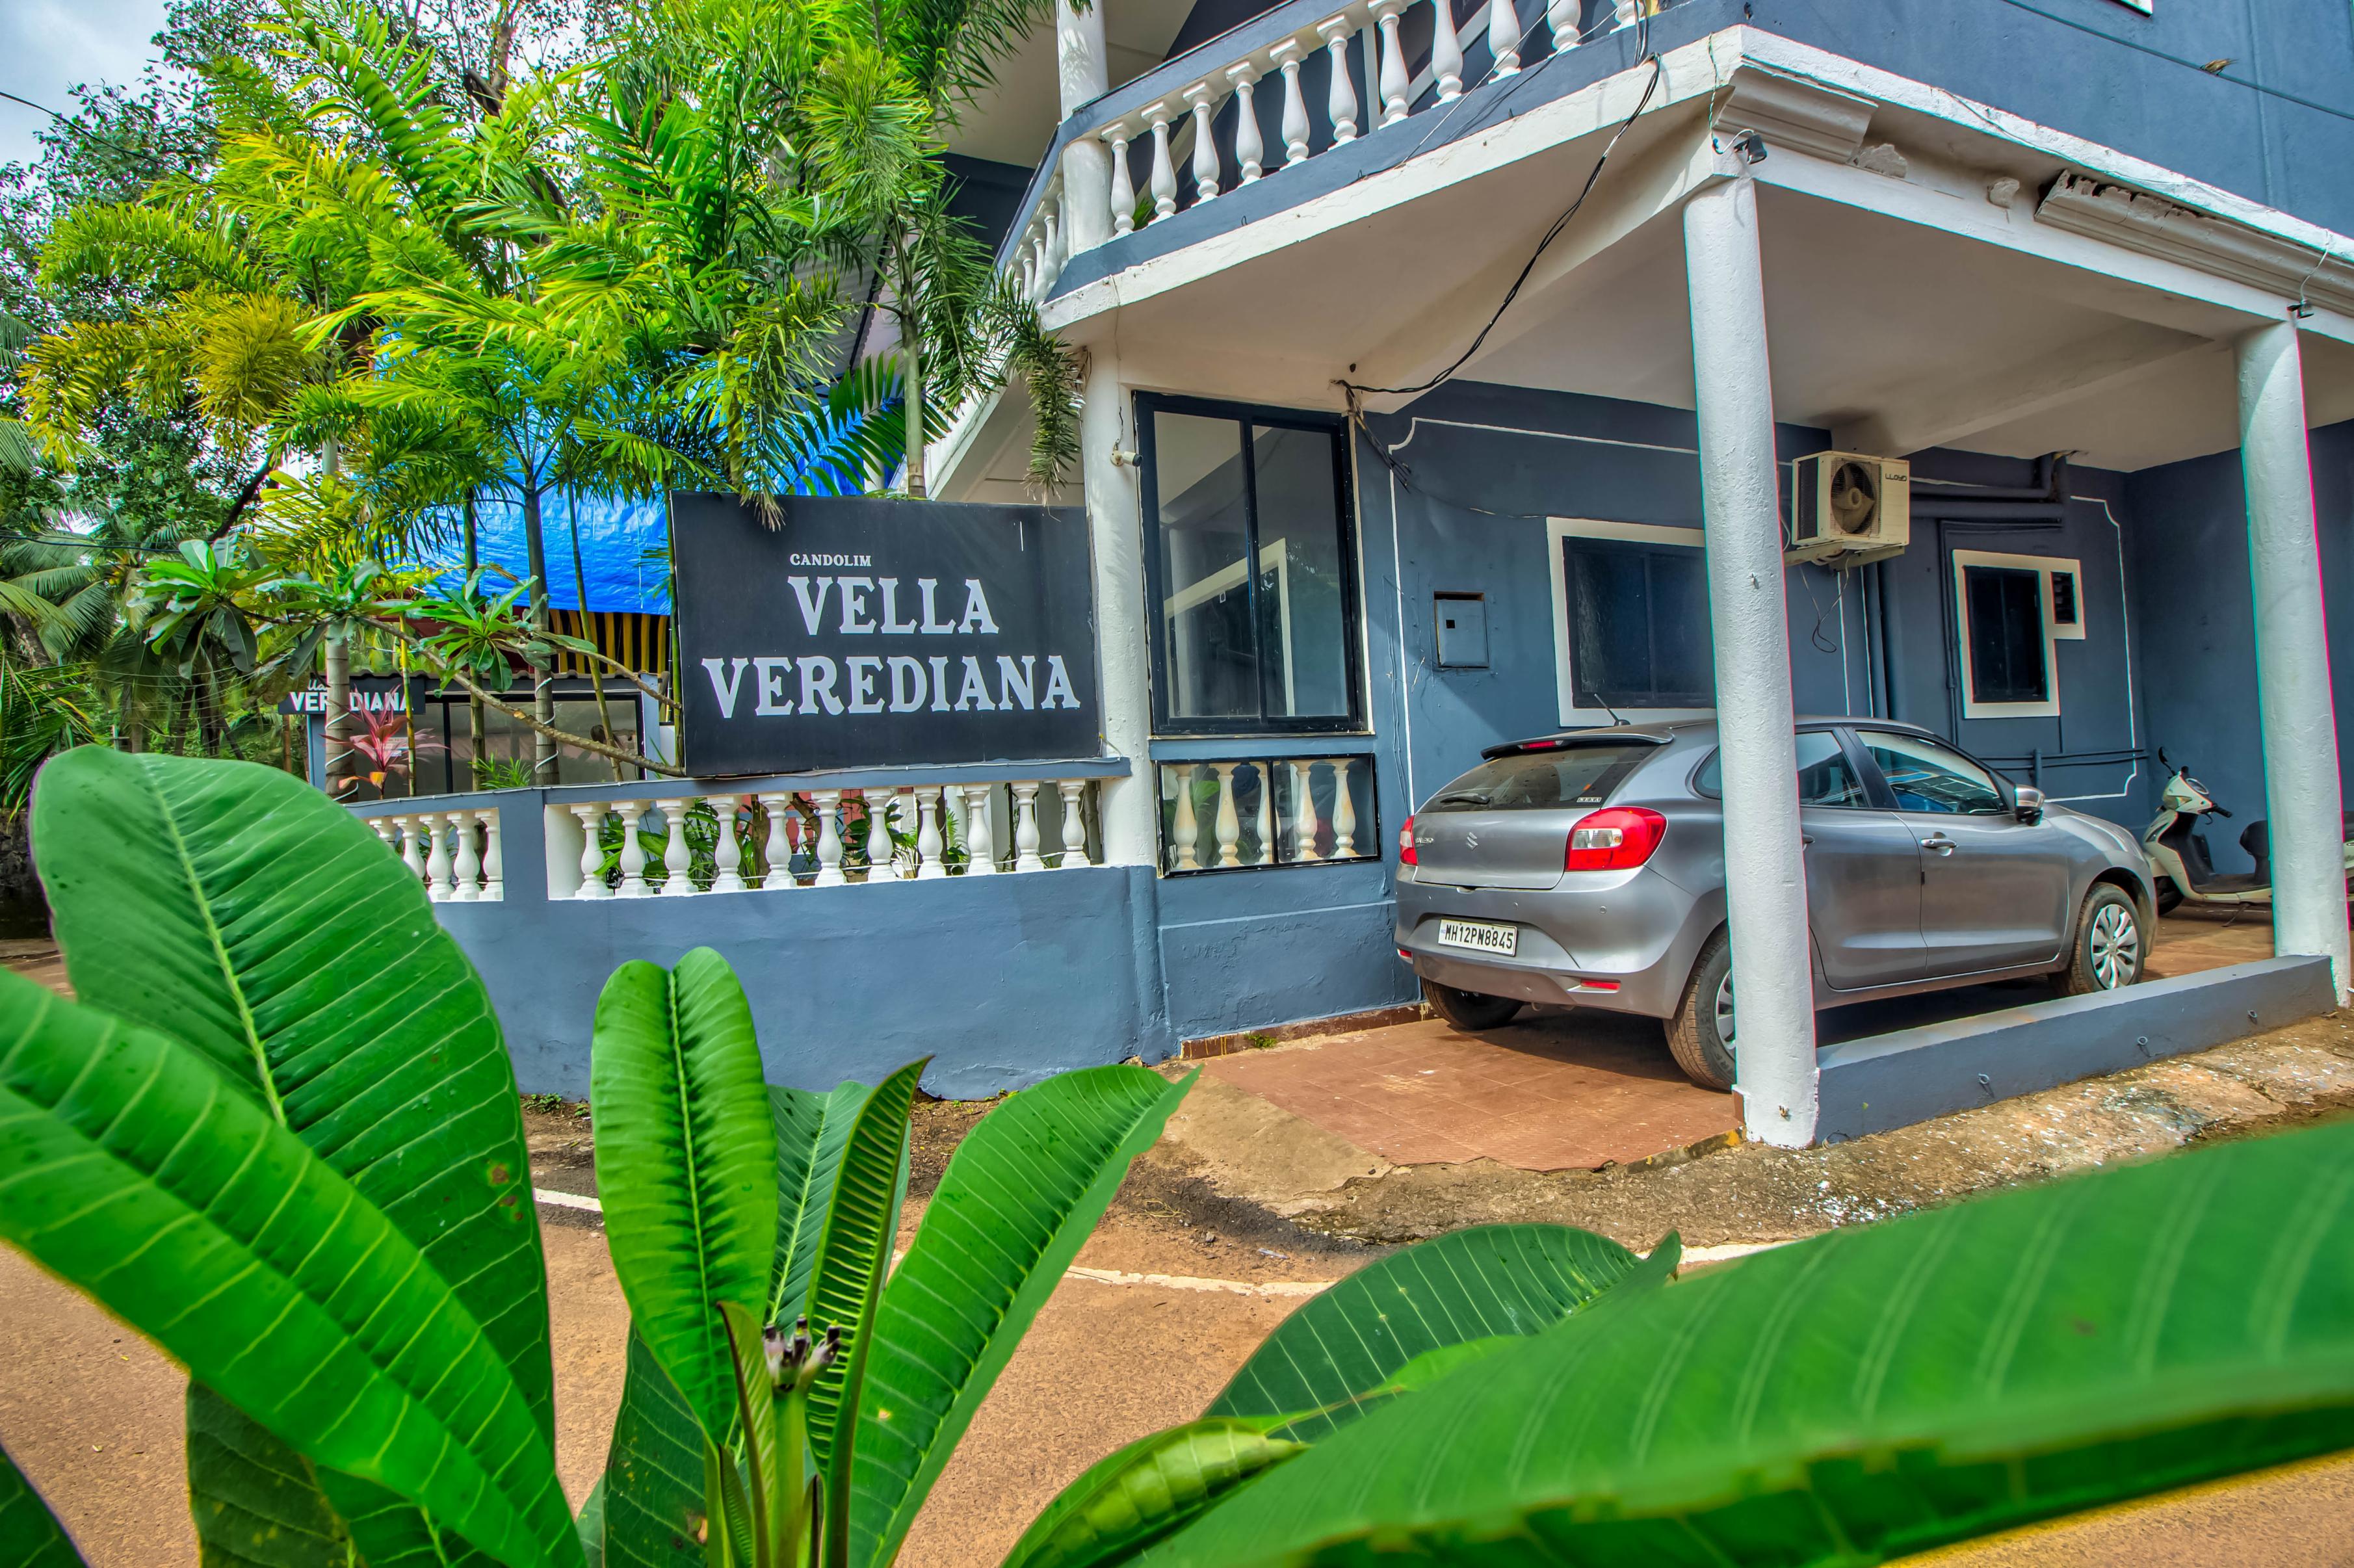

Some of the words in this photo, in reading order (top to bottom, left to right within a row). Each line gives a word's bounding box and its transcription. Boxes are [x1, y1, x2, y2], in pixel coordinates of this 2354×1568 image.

[1885, 473, 1907, 482] LLOYD
[790, 553, 872, 567] CANDOLIM
[787, 576, 999, 635] VELLA
[701, 655, 1081, 718] VEREDIANA
[1445, 924, 1513, 949] MH12PN8845
